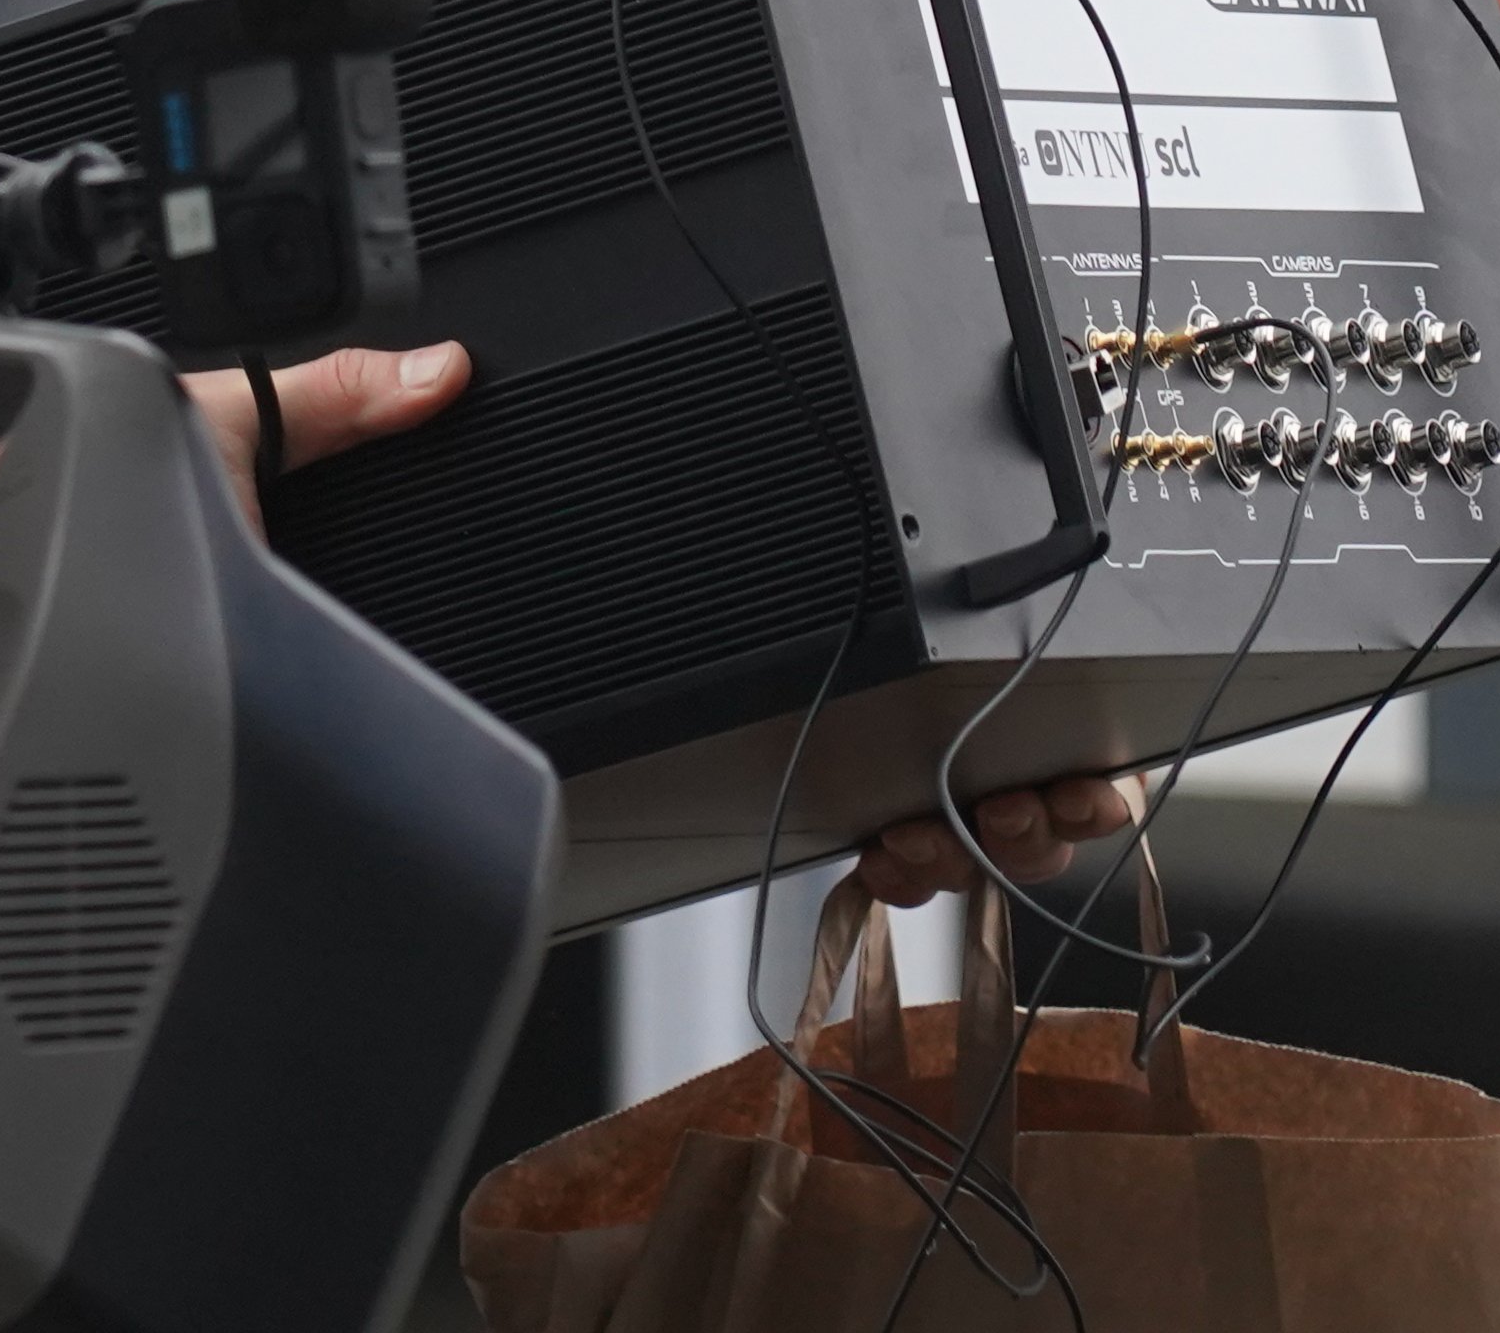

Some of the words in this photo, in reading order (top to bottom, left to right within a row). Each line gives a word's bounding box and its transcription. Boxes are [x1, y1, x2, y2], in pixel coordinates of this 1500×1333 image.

[1056, 129, 1151, 179] NTNU
[1154, 125, 1202, 178] scl
[1072, 252, 1143, 270] ANTENNAS
[1271, 255, 1335, 272] CAMERAS
[1246, 280, 1258, 297] 3
[1303, 283, 1314, 299] 5
[1358, 284, 1369, 299] 7
[1414, 286, 1426, 302] 9
[1111, 299, 1122, 315] 3
[1157, 389, 1185, 407] GPS
[1127, 486, 1139, 503] 2
[1160, 485, 1170, 502] 4
[1189, 486, 1202, 503] R
[1246, 504, 1257, 521] 2
[1358, 504, 1370, 521] 6
[1414, 504, 1426, 521] 8
[1468, 504, 1484, 521] 10
